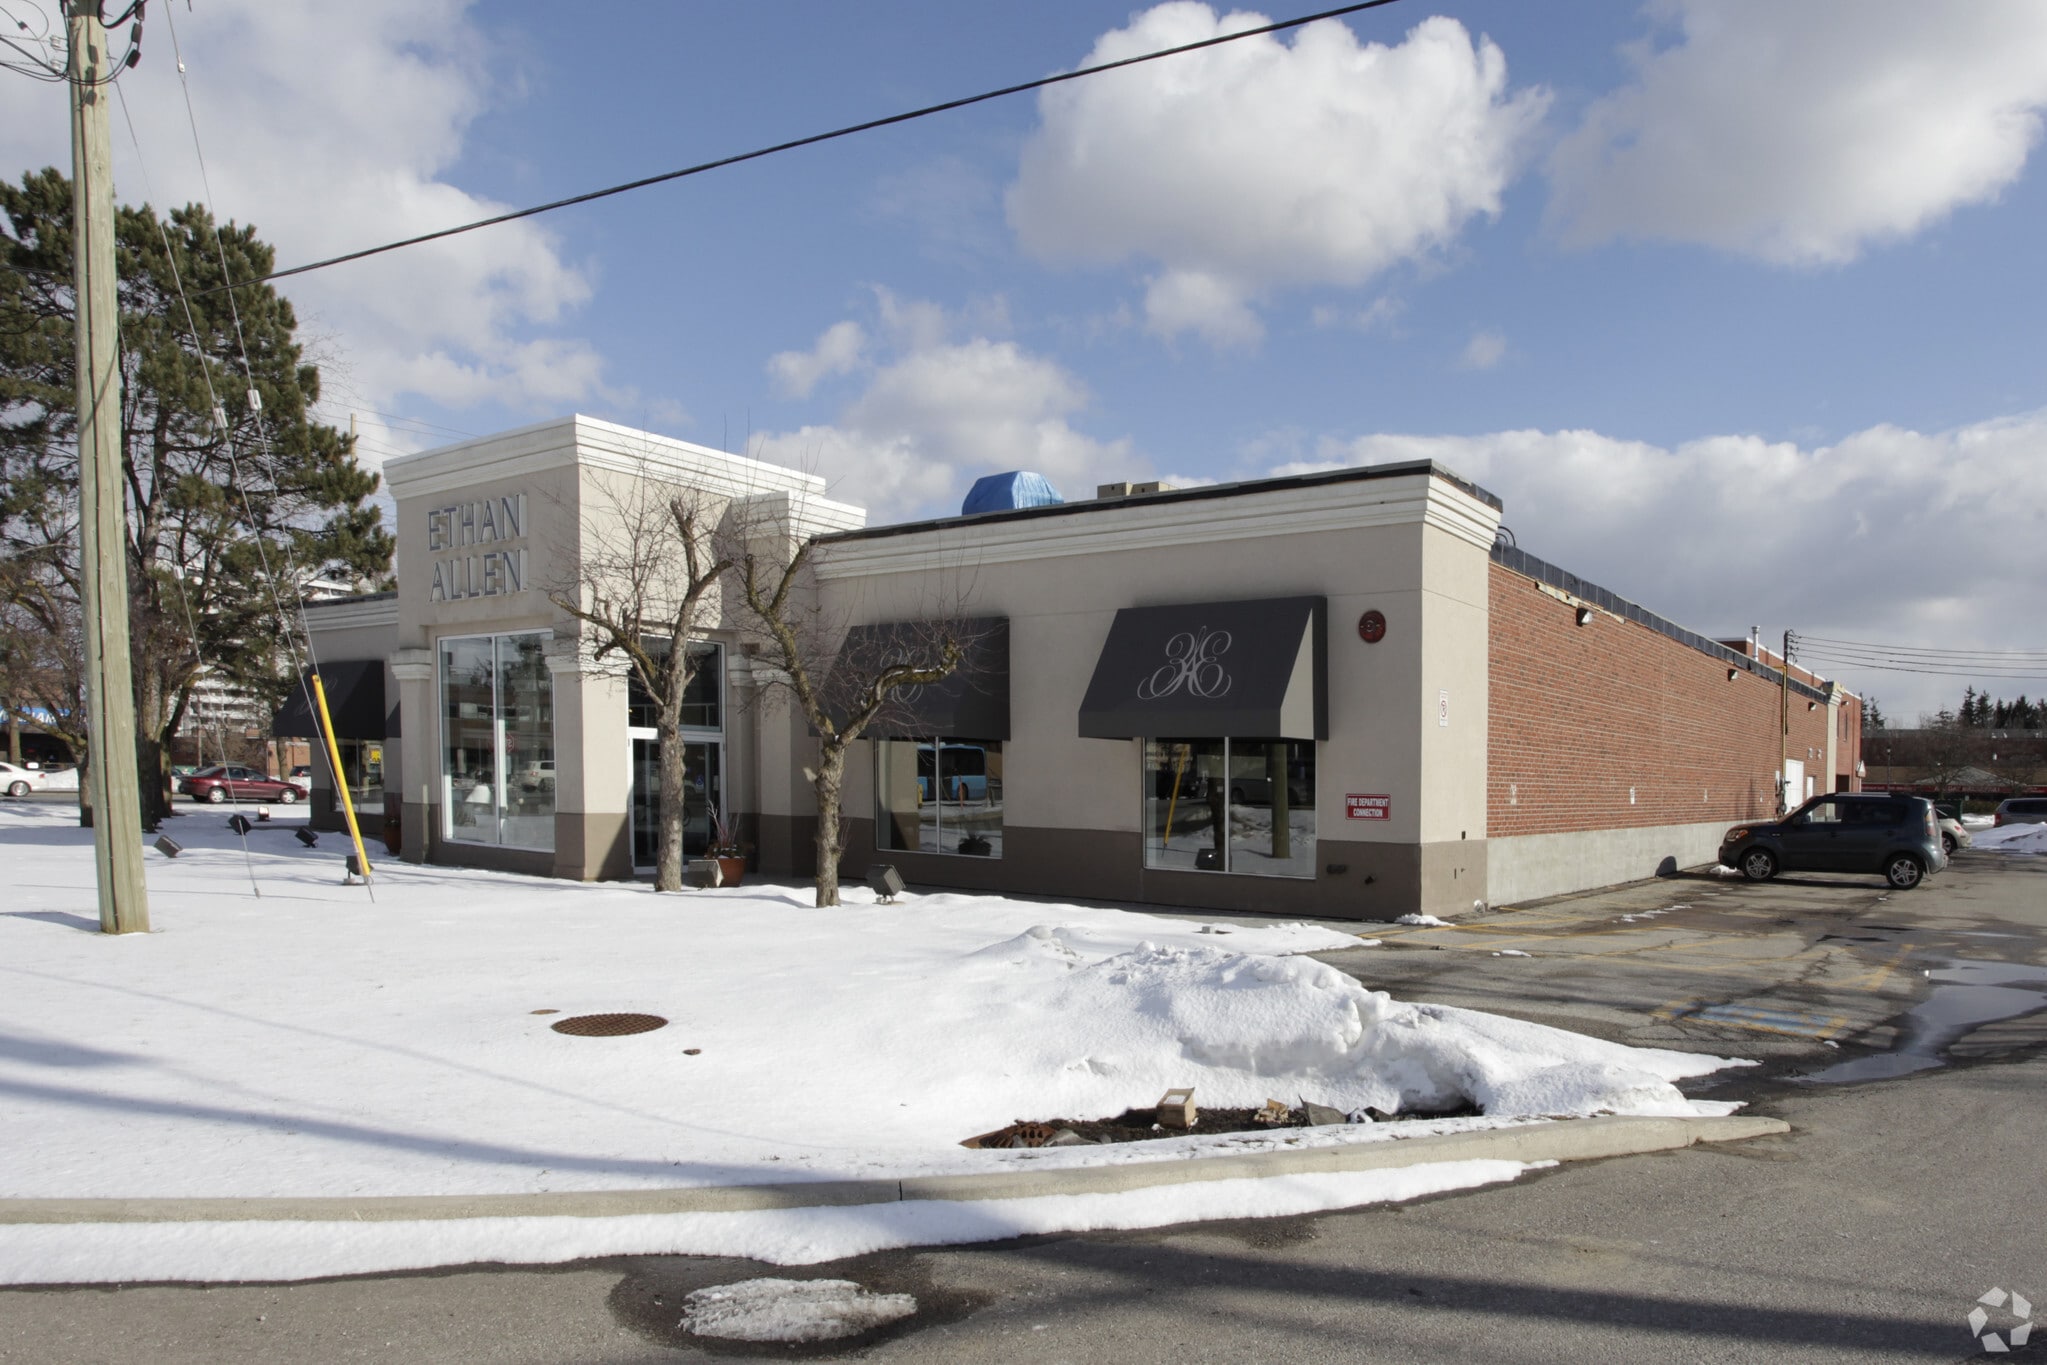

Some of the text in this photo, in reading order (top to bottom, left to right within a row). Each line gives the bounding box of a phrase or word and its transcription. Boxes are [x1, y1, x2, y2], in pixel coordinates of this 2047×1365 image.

[428, 493, 528, 551] ETHAN
[429, 549, 528, 602] ALLEN
[1353, 808, 1383, 817] CONNECTION
[1358, 798, 1389, 807] DEPARTMENT
